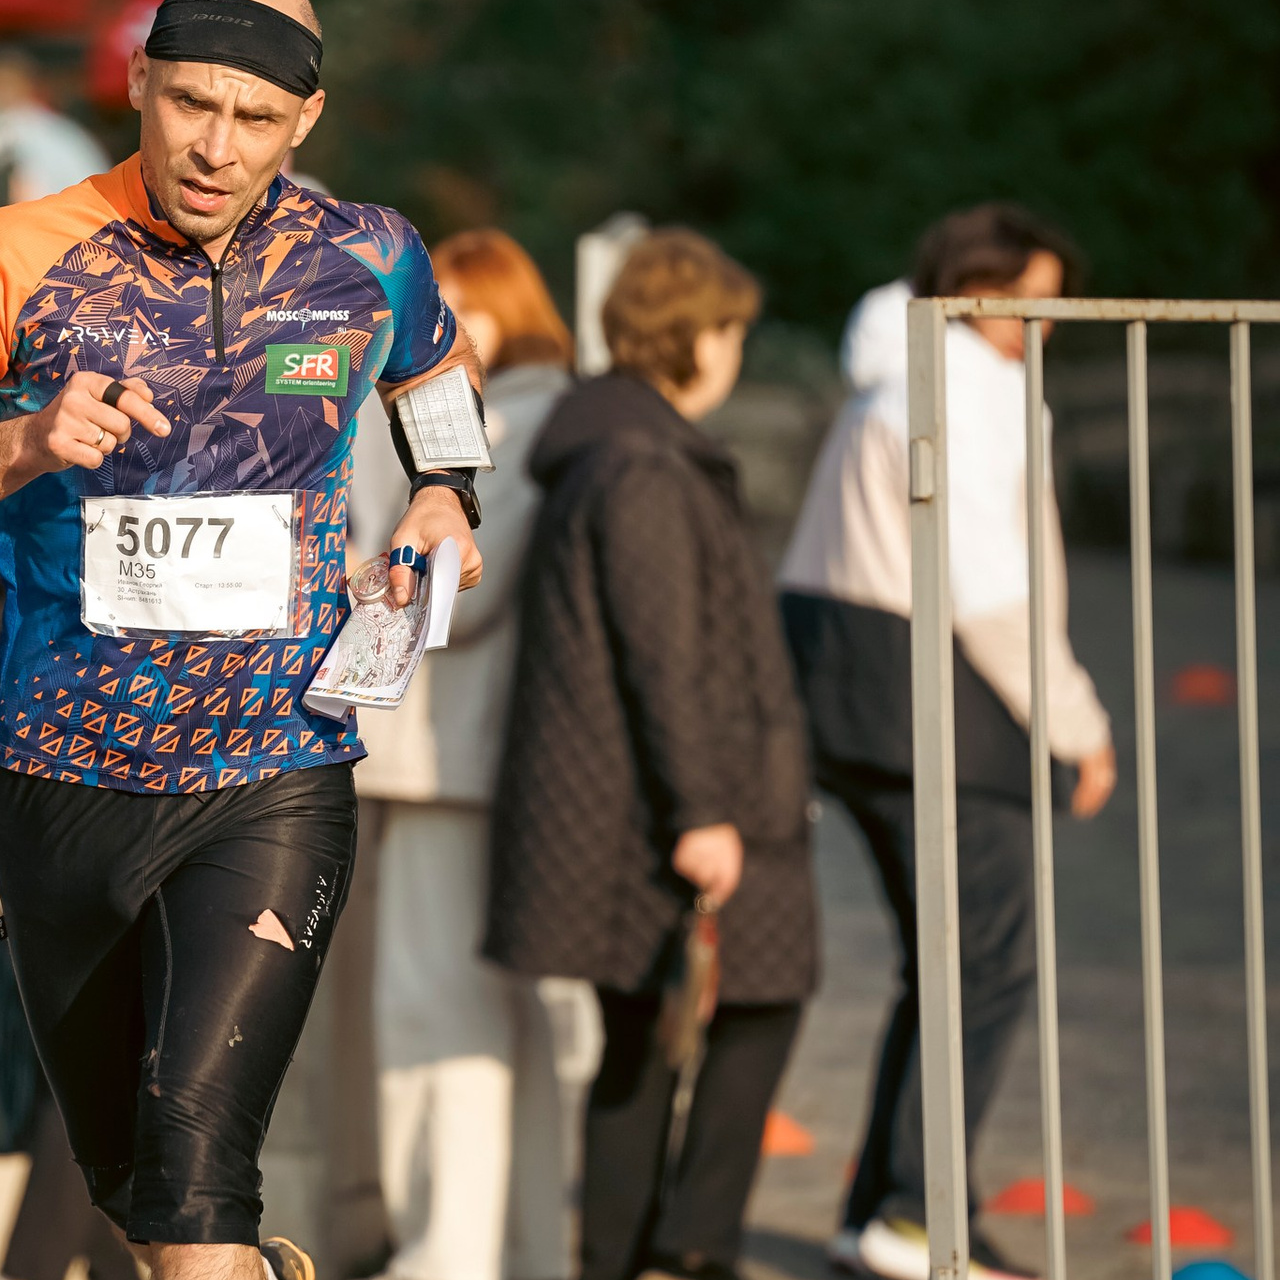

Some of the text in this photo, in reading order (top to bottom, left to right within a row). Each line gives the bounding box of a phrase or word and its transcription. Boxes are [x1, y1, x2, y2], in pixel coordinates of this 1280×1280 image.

[282, 353, 334, 376] SFR
[302, 380, 336, 388] orienteering
[116, 515, 235, 559] 5077
